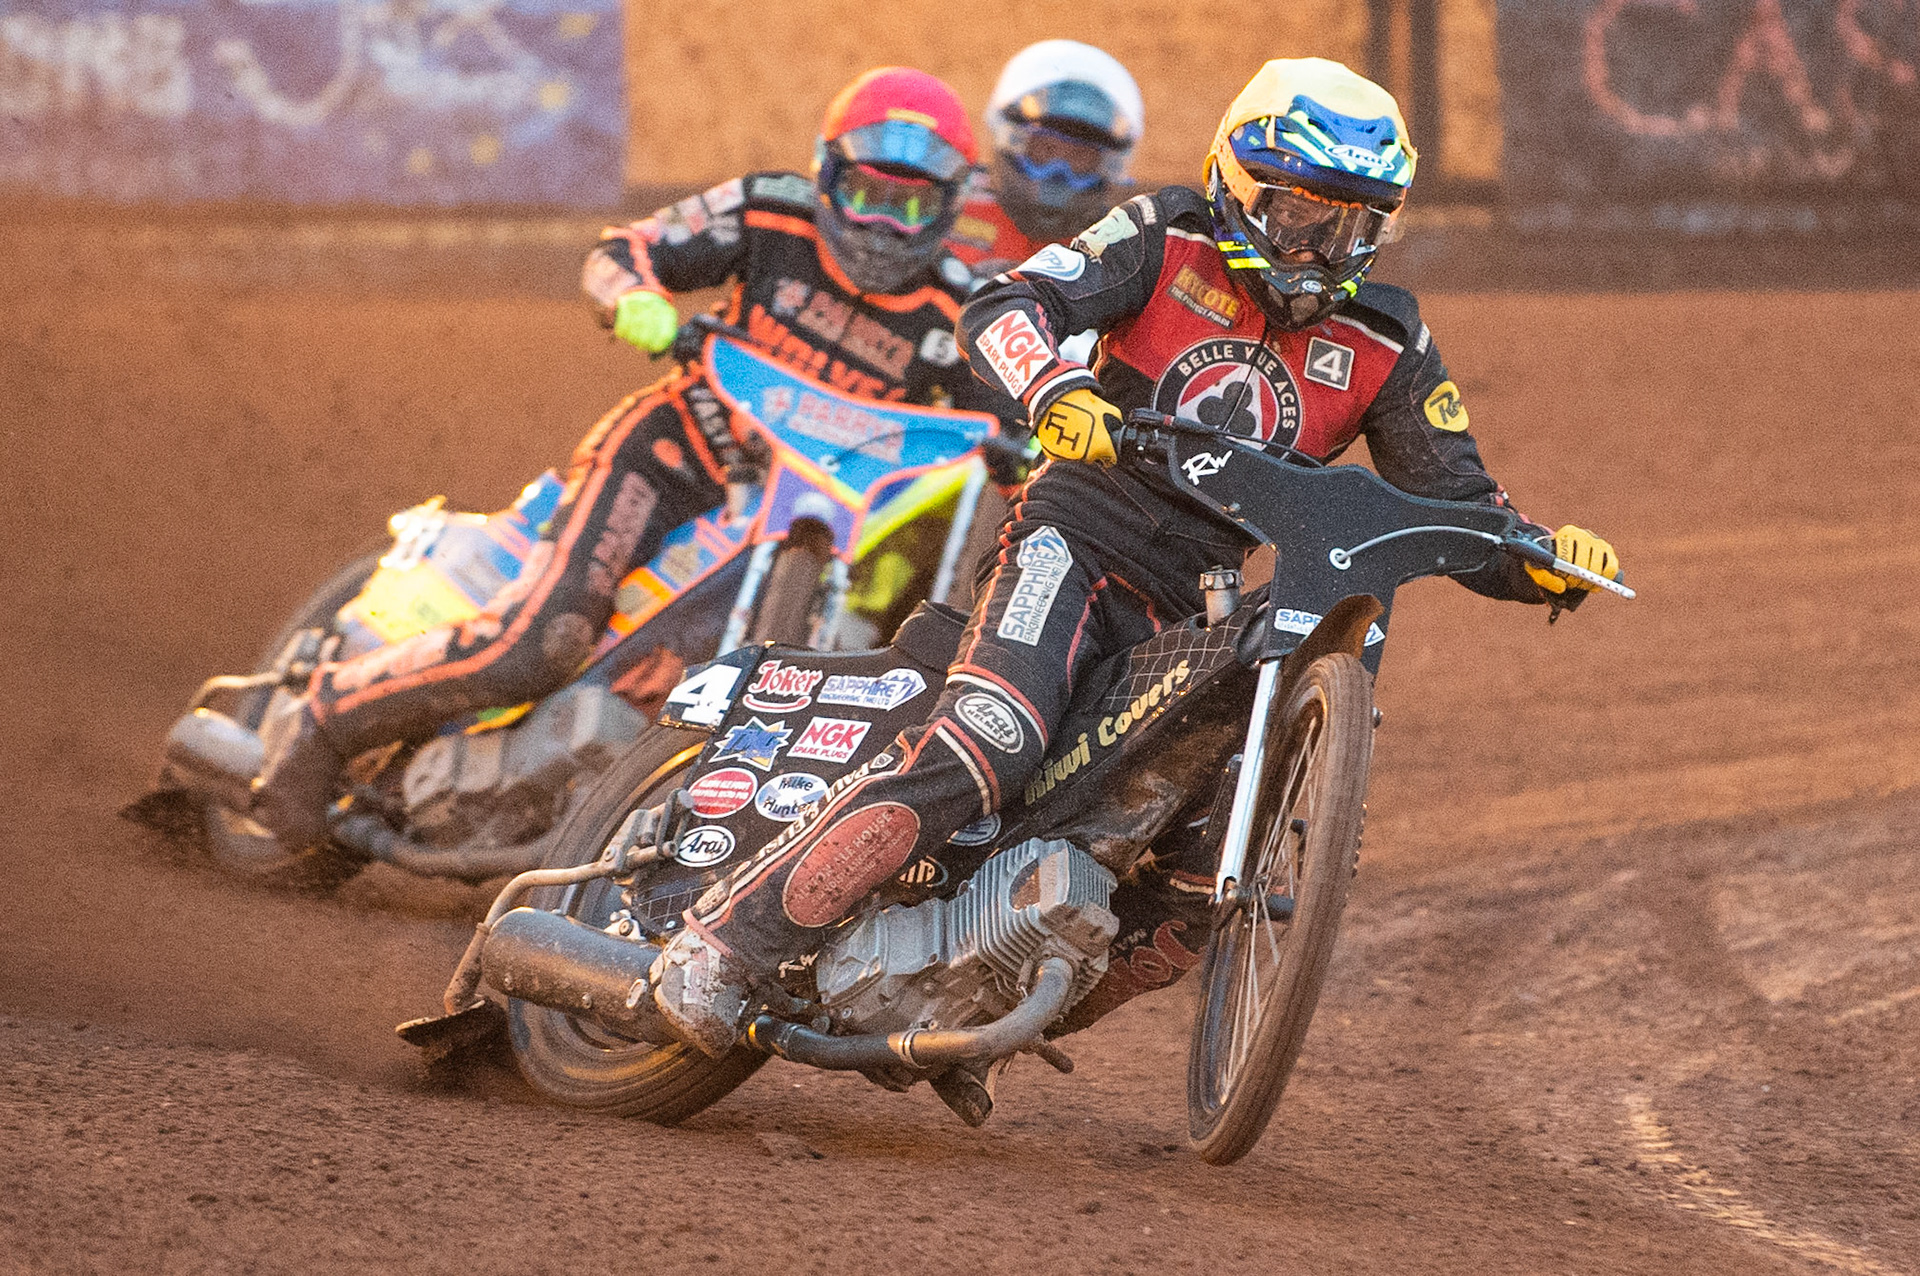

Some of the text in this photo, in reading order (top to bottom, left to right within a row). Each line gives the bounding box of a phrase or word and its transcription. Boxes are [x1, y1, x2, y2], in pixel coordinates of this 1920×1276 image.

[979, 334, 1024, 395] SPARK PLUGS
[989, 312, 1049, 382] NGK
[1312, 349, 1343, 382] 4
[1177, 344, 1297, 430] BELLE VUE ACES
[1002, 551, 1058, 639] SAPPHIRE
[1024, 581, 1055, 643] ENGINEERING
[665, 664, 742, 727] 4
[750, 660, 822, 695] Joker
[823, 677, 897, 698] SAPPHIRE
[1097, 659, 1191, 747] Covers
[792, 745, 850, 760] SPARK PLUGS
[799, 722, 865, 750] NGK
[778, 776, 814, 791] Mike
[684, 832, 725, 854] Arai
[851, 810, 893, 849] HOUSE
